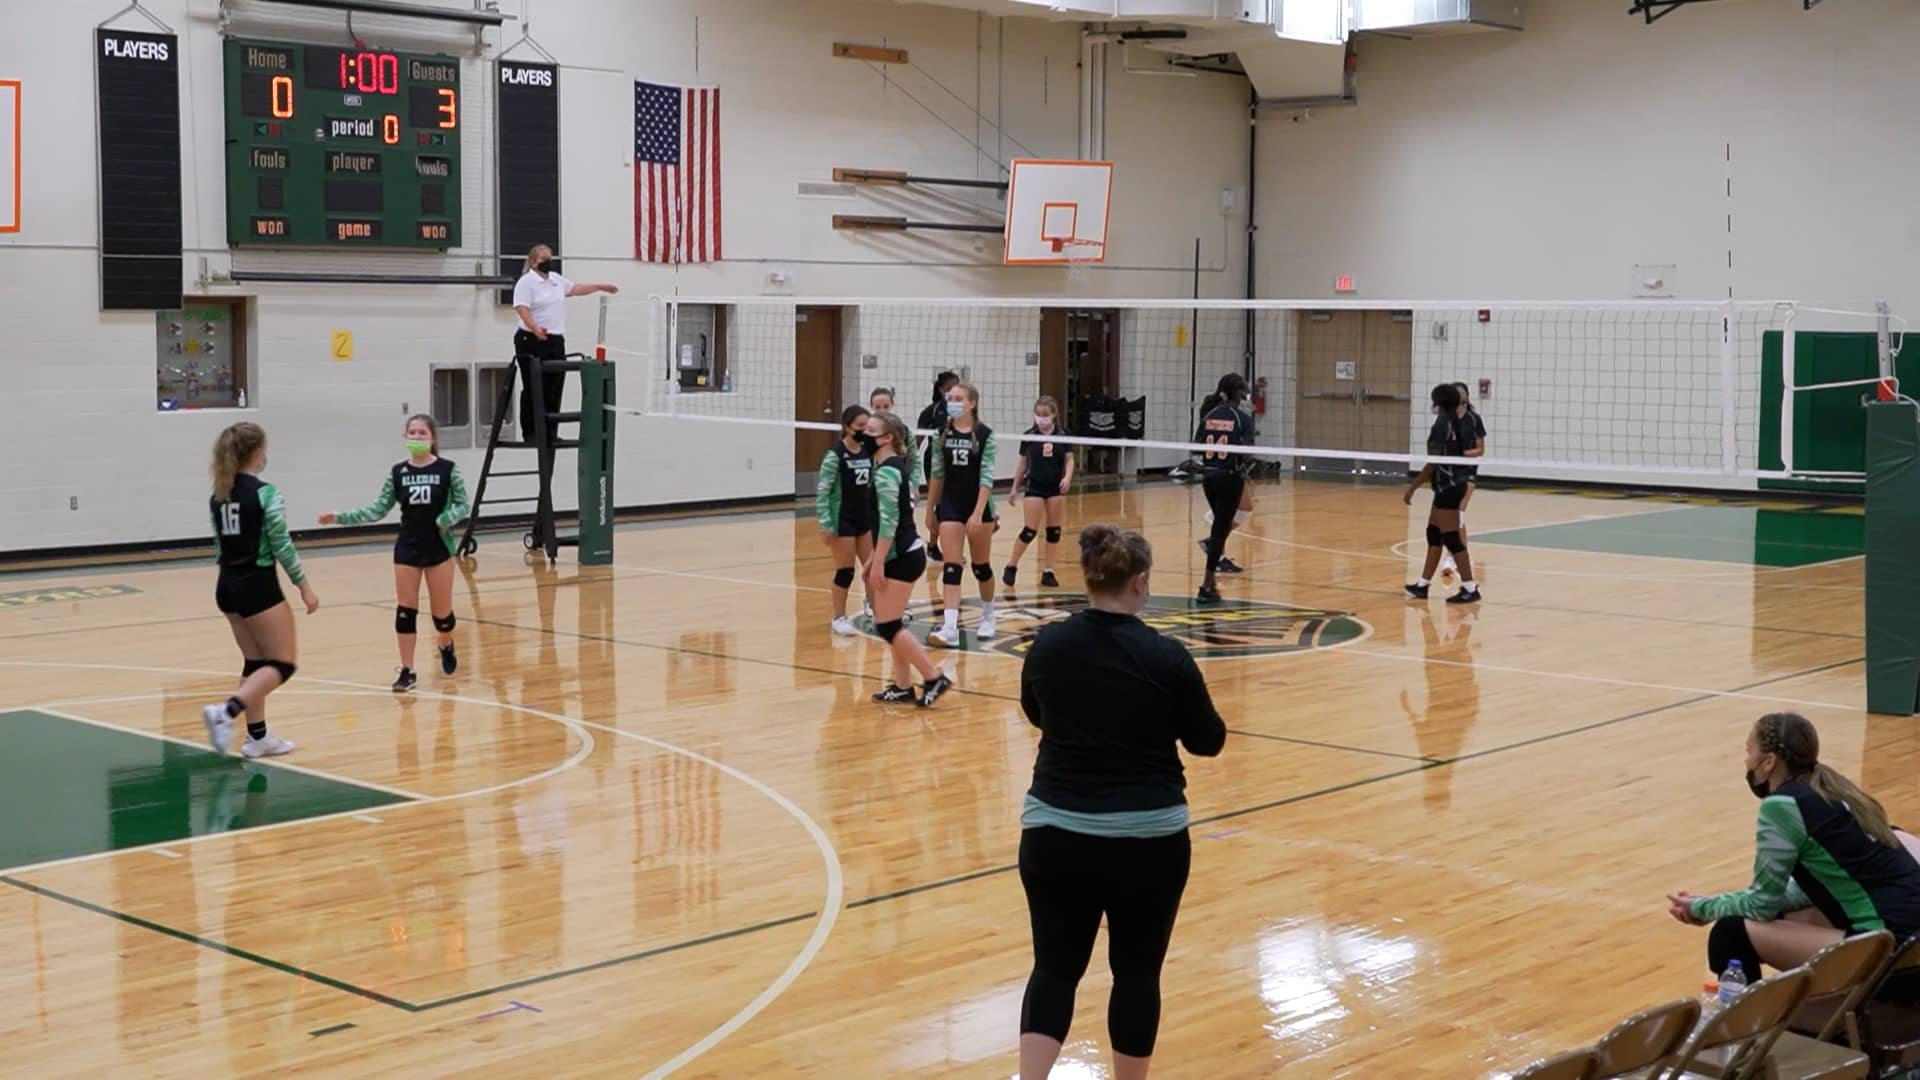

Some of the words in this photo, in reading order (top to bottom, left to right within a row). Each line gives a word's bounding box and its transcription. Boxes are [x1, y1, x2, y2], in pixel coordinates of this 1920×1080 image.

[104, 38, 168, 61] PLAYERS
[248, 47, 287, 68] Home
[340, 52, 398, 94] 1:00
[412, 61, 455, 82] Guests
[501, 67, 552, 87] PLAYERS
[272, 76, 293, 118] 0
[438, 88, 455, 128] 3
[331, 119, 374, 137] period
[383, 114, 399, 144] 0
[254, 149, 286, 169] fouls
[332, 151, 374, 173] player
[256, 220, 284, 235] won
[338, 223, 371, 240] game
[422, 225, 446, 239] won
[336, 333, 350, 358] 2
[951, 449, 969, 466] 13
[854, 467, 870, 486] 23
[408, 485, 432, 505] 20
[220, 502, 241, 536] 16
